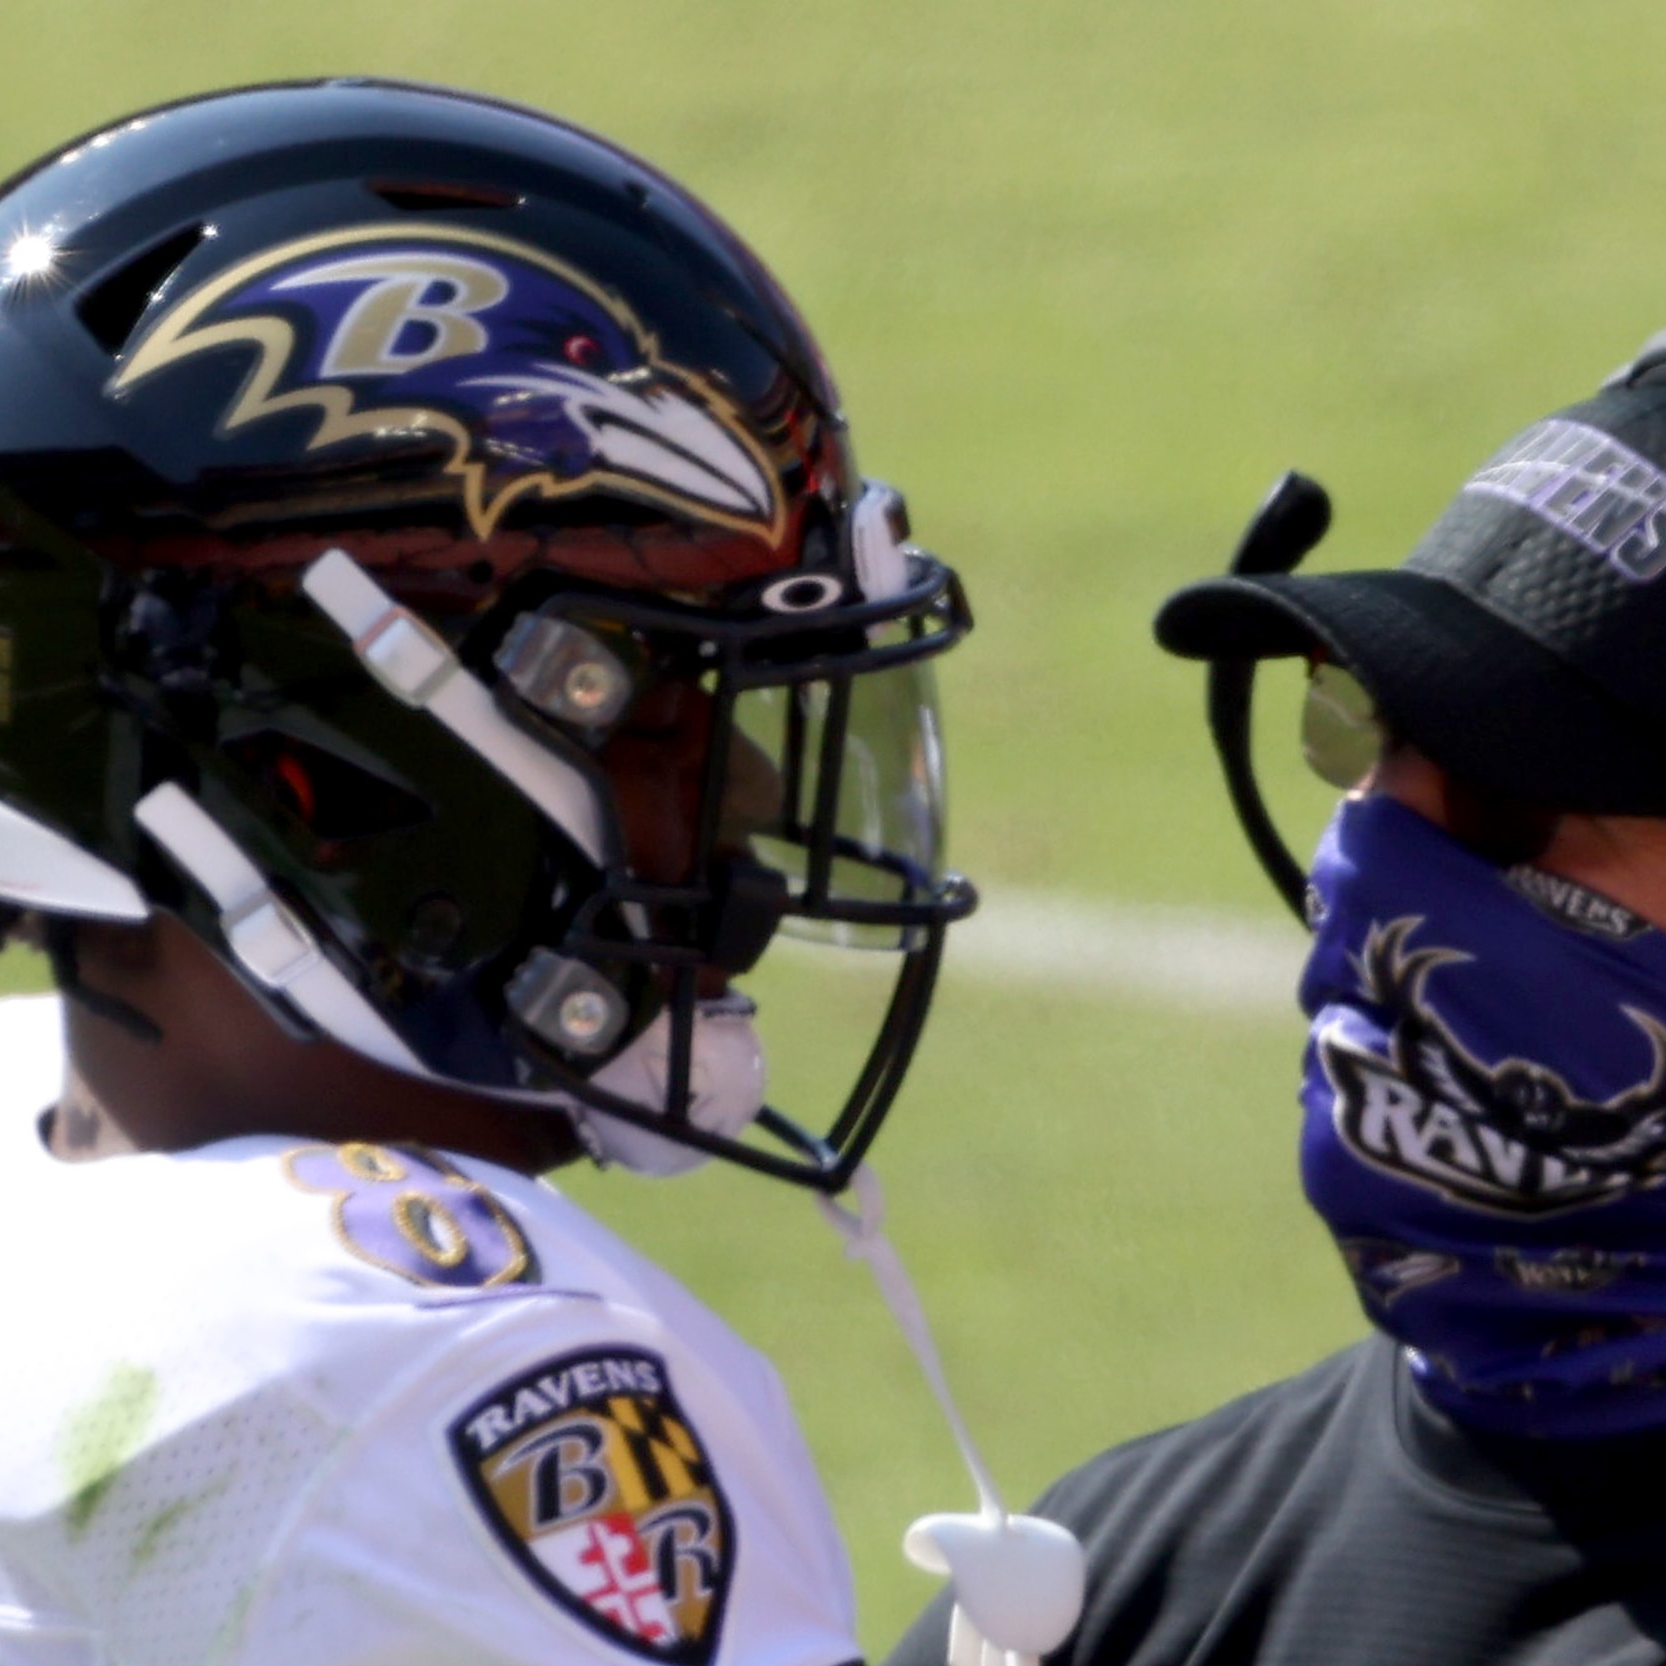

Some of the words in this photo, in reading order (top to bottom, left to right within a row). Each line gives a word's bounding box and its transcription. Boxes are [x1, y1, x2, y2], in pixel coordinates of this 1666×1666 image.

[270, 250, 509, 379] B
[280, 1141, 542, 1290] 8
[465, 1357, 663, 1452] RAVENS
[491, 1414, 613, 1538] B
[637, 1501, 718, 1608] R
